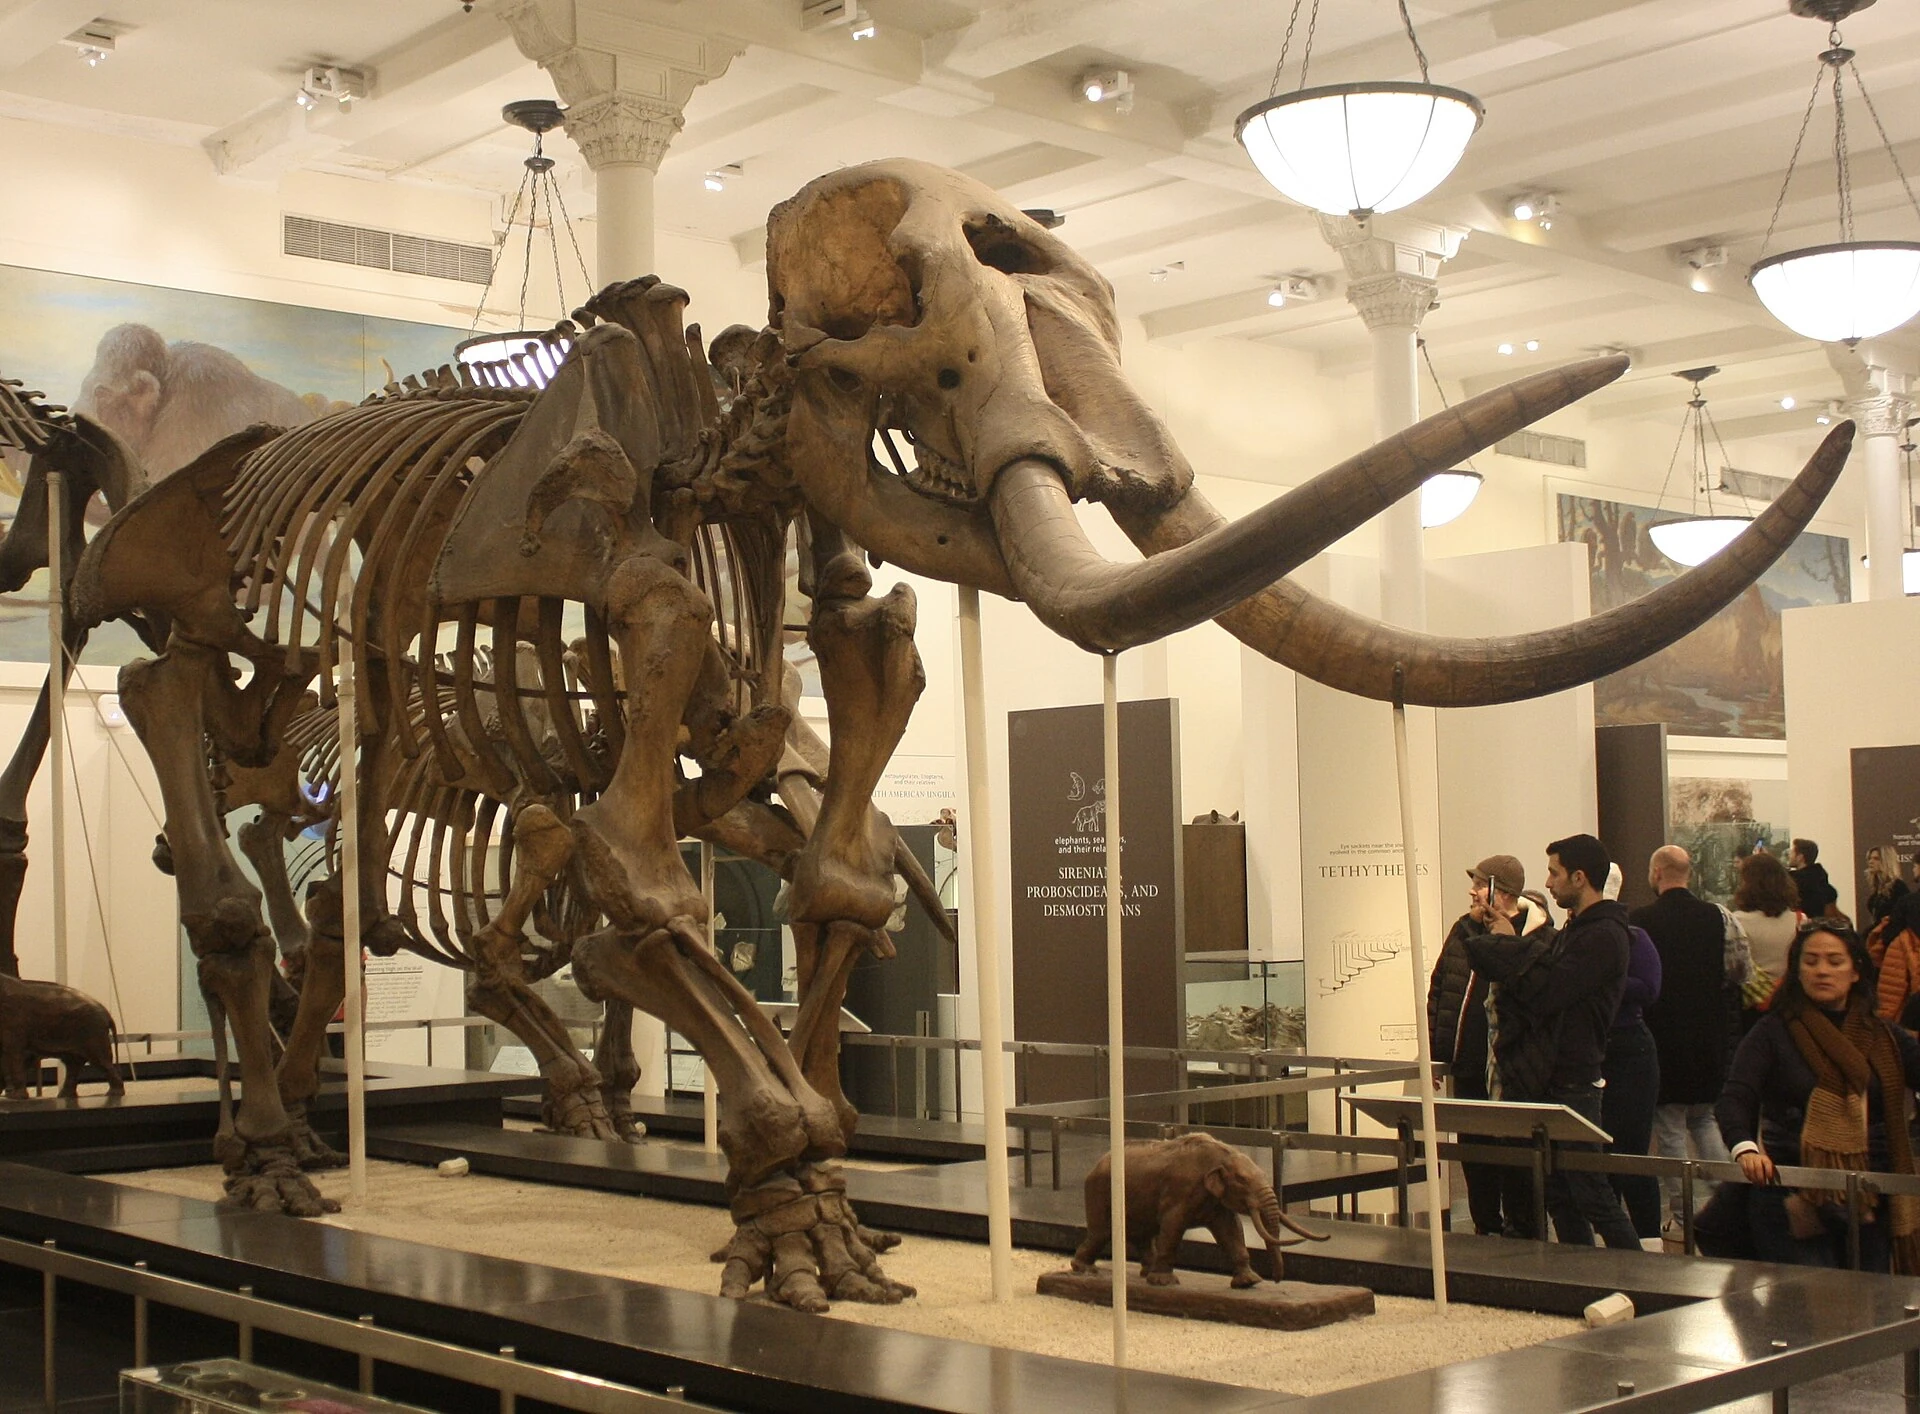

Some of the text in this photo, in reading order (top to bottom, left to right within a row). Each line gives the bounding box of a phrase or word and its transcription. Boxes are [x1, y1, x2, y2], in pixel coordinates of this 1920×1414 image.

[888, 790, 925, 798] AMERICAN
[926, 790, 956, 799] UNGULA
[1054, 836, 1105, 846] elephants, sea
[1058, 845, 1124, 854] and their relas
[1058, 866, 1123, 880] SIRENIA,
[1318, 864, 1429, 878] TETHYTHEES
[1026, 884, 1159, 900] PROBOSCIDEAS, AND
[1043, 904, 1141, 917] DESMOSTYANS
